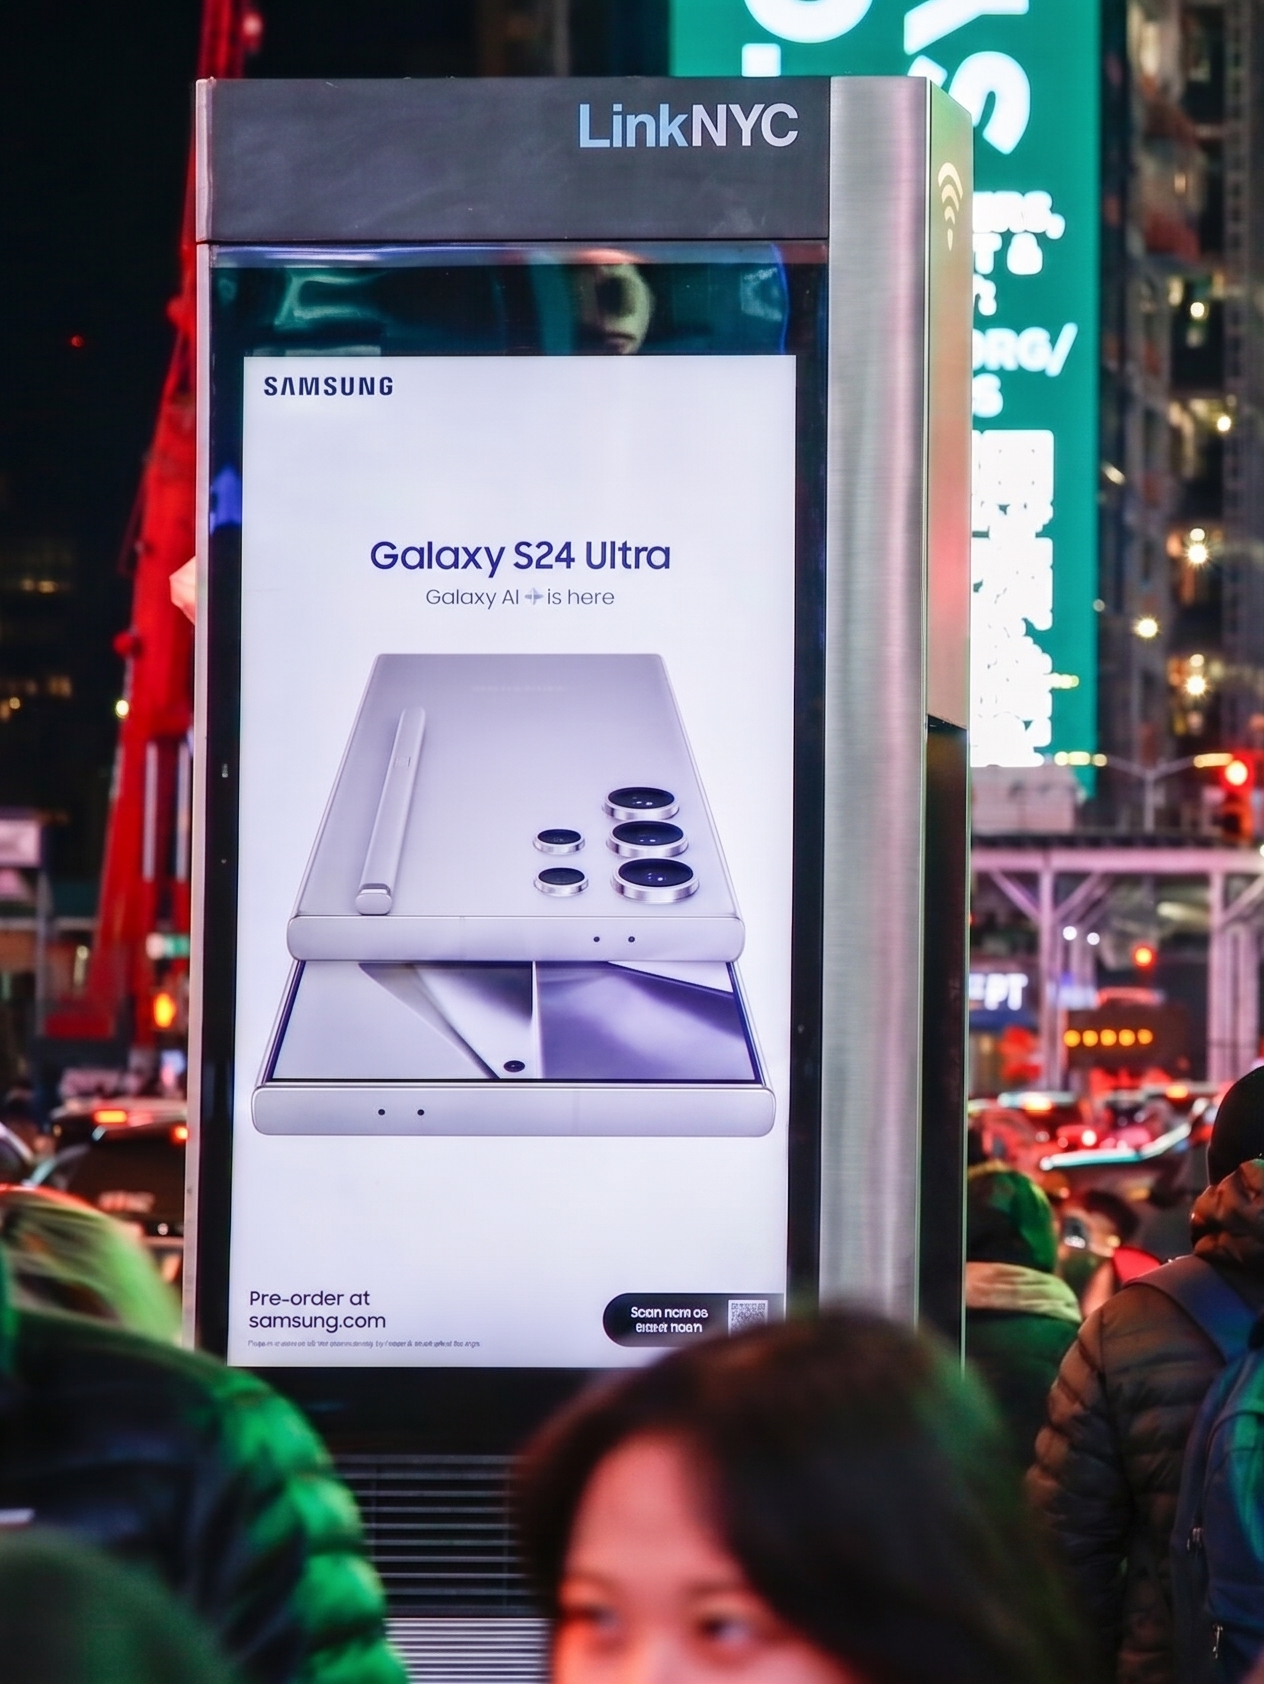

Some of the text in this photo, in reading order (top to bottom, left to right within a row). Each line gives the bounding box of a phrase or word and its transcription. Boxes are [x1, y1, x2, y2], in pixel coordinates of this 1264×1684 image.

[579, 102, 799, 149] LinkNYC
[263, 375, 394, 398] SAMSUNG
[370, 540, 671, 579] Galaxy S24 Ultra
[425, 588, 615, 611] Galaxy AI is here
[249, 1290, 371, 1307] Pre-order at
[248, 1315, 386, 1334] samsung.com
